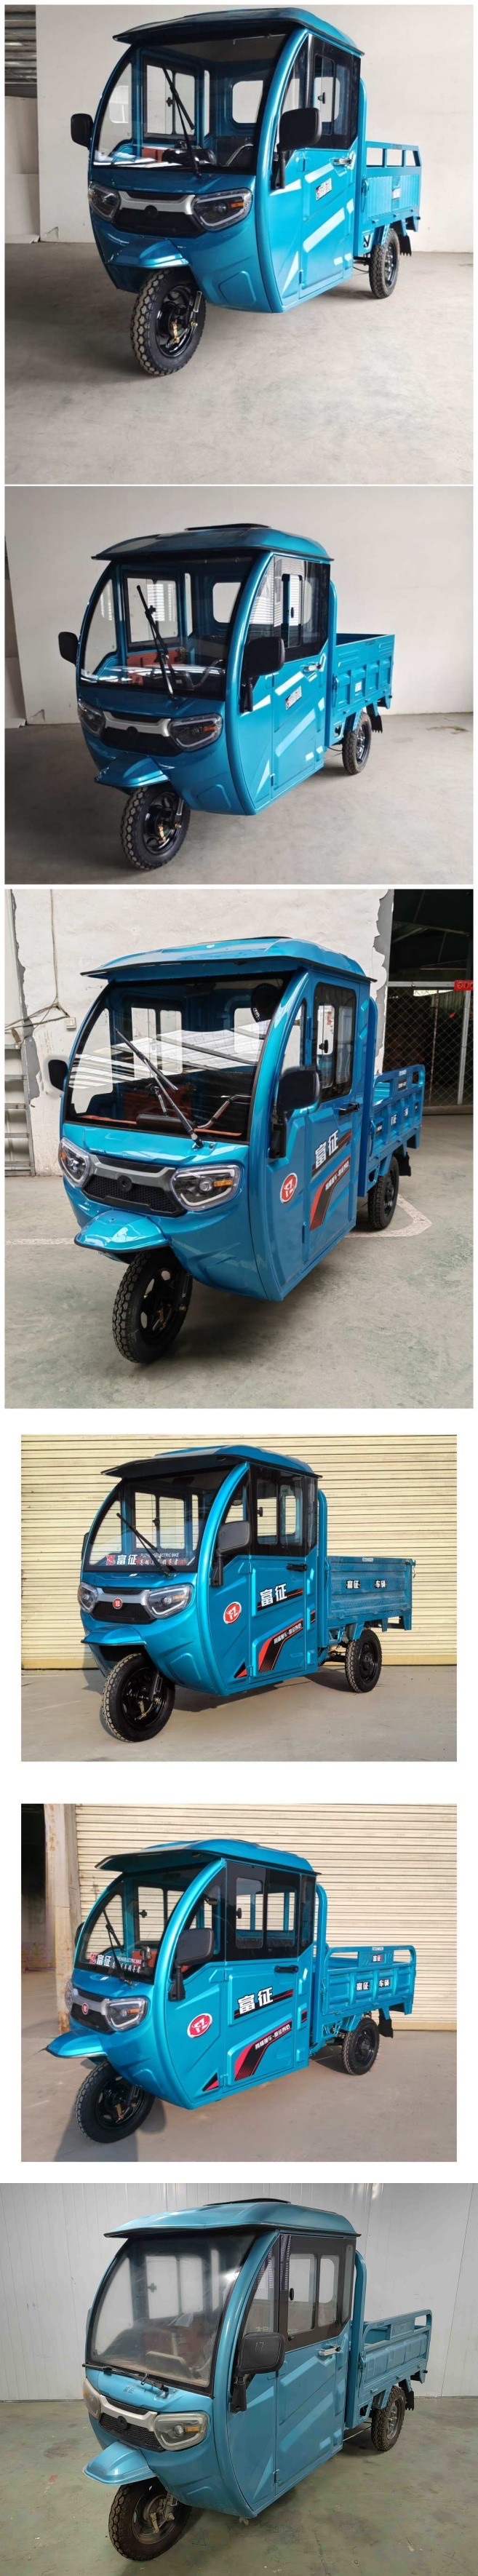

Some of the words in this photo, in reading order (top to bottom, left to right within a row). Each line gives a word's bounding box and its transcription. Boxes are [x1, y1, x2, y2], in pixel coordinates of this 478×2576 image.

[315, 1130, 338, 1169] 富征
[116, 1554, 138, 1565] 富征
[260, 1583, 287, 1607] 富征
[96, 1954, 111, 1967] 富征
[238, 1987, 274, 2014] 富征
